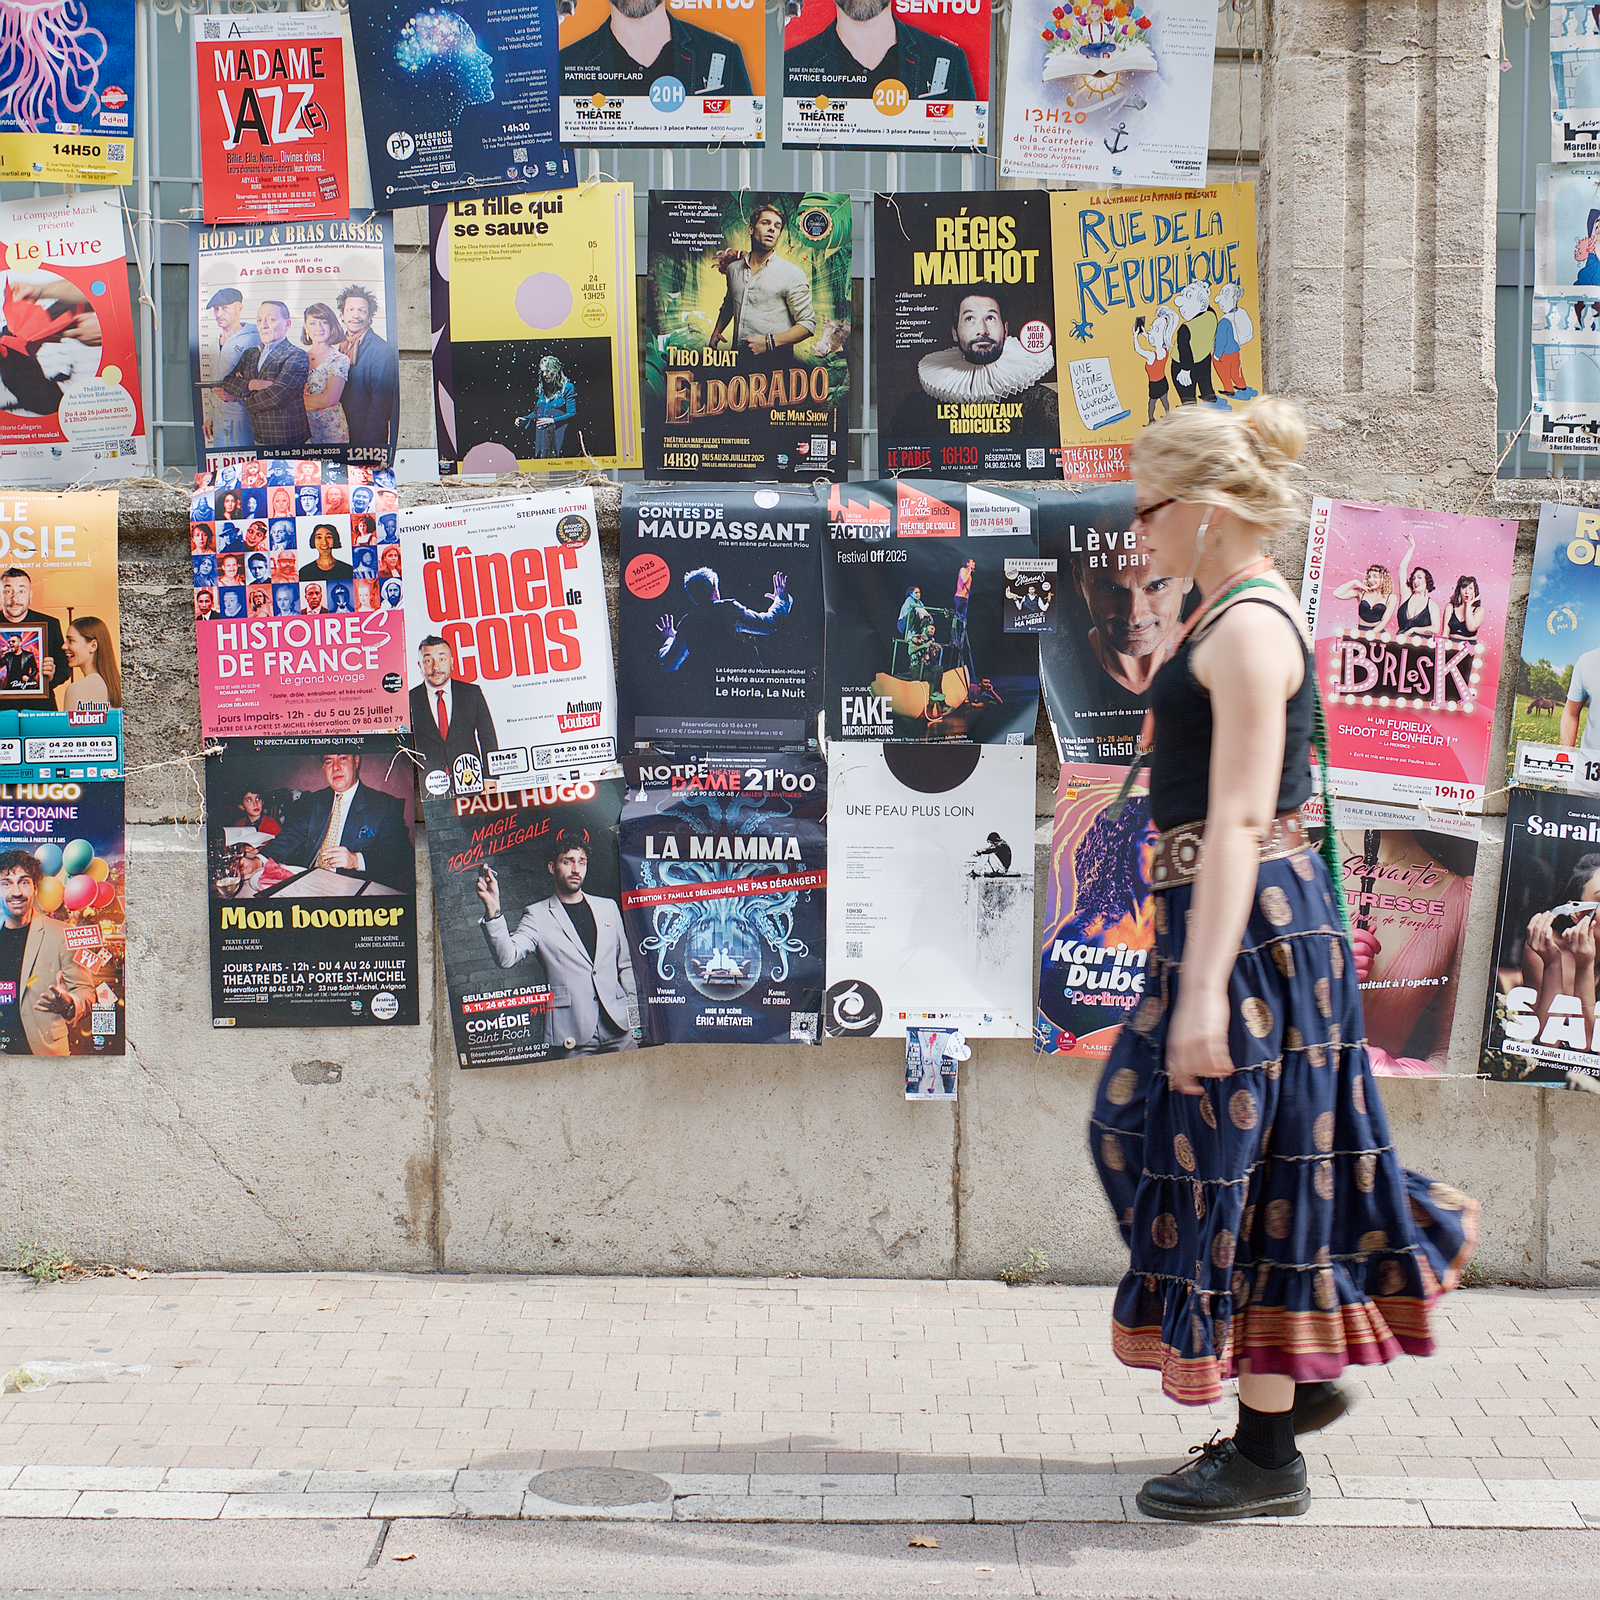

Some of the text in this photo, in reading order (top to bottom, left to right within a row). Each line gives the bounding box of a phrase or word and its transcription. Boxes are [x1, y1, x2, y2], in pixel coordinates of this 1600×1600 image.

[896, 0, 980, 14] SENTOU
[214, 48, 326, 82] MADAME
[822, 75, 867, 83] SOUFFLARD
[652, 86, 683, 102] 20H
[876, 90, 907, 106] 20H
[576, 108, 622, 119] THÉÂTRE
[799, 110, 844, 121] THÉÂTRE
[1025, 109, 1087, 124] 13H20
[415, 130, 452, 140] PRÉSENCE
[502, 123, 530, 133] 14h30
[1033, 125, 1072, 135] Théâtre
[415, 138, 453, 147] PASTEUR
[1029, 135, 1037, 143] la
[1042, 136, 1094, 146] Carreterie
[1564, 142, 1597, 151] Marelle
[53, 144, 101, 156] 14H50
[281, 150, 321, 162] Divines divas
[12, 205, 97, 221] La Compagnie Mazik
[454, 195, 563, 219] La fille qui
[37, 220, 75, 231] présente
[454, 221, 548, 237] se sauve
[936, 207, 1016, 250] RÉGIS
[199, 229, 264, 251] HOLD-UP
[270, 227, 280, 244] &
[285, 224, 324, 243] BRAS
[1079, 209, 1222, 257] RUE DE LA
[14, 238, 102, 260] Le Livre
[240, 265, 341, 276] Arsène Mosca
[913, 250, 1039, 285] MAILHOT
[581, 283, 606, 291] JUILLET
[1073, 362, 1092, 376] UNE
[937, 403, 1023, 419] LES NOUVEAUX
[950, 418, 1011, 434] RIDICULES
[1542, 434, 1591, 444] Marelle des
[347, 448, 387, 462] 12H25
[663, 453, 698, 467] 14H30
[941, 447, 978, 464] 16H30
[1065, 447, 1122, 461] THÉÂTRE DES
[1064, 461, 1090, 474] CORPS
[516, 504, 587, 518] STEPHANE BATTINI
[639, 507, 724, 520] CONTES DE
[931, 507, 950, 516] 15h35
[970, 505, 1020, 514] www.la-factory.org
[400, 519, 467, 534] NTHONY JOUBERT
[638, 520, 810, 541] MAUPASSANT
[422, 543, 435, 559] le
[837, 550, 907, 563] Festival Off 2025
[1309, 508, 1328, 594] du GIRASOLE
[1090, 553, 1107, 568] et
[632, 560, 655, 576] 16h25
[423, 545, 578, 622] dîner
[566, 588, 582, 606] de
[441, 609, 581, 684] cons
[218, 647, 380, 678] DE FRANCE
[280, 673, 365, 686] Le grand voyage
[716, 687, 805, 698] Le Horla, La Nuit
[77, 700, 110, 712] Anthony
[567, 700, 602, 714] Anthony
[841, 696, 893, 725] FAKE
[70, 712, 105, 724] Joubert
[560, 713, 597, 730] Joubert
[842, 725, 893, 736] MICROFICTIONS
[1387, 720, 1432, 733] FURIEUX
[1338, 725, 1443, 746] SHOOT DE BONHEUR
[491, 753, 518, 761] 11h45
[1098, 743, 1133, 757] 15h50
[639, 764, 708, 781] NOTRE
[671, 774, 741, 791] DAME
[17, 783, 80, 800] HUGO
[1434, 786, 1475, 800] 19h10
[457, 782, 596, 816] PAUL HUGO
[18, 807, 78, 818] FORAINE
[846, 805, 974, 817] UNE PEAU PLUS LOIN
[0, 820, 53, 833] AGIQUE
[471, 813, 518, 844] MAGIE
[1527, 815, 1600, 842] Sarah
[488, 818, 550, 856] ILLEGALE
[645, 836, 802, 860] LA MAMMA
[1341, 855, 1448, 891] Servante
[737, 877, 816, 892] NE PAS DÉRANGER
[1346, 890, 1445, 916] TRESSE
[221, 905, 404, 930] Mon boomer
[67, 929, 93, 938] SUCCÈS
[69, 936, 99, 946] REPRISE
[1051, 940, 1147, 967] Karin
[223, 959, 405, 973] JOURS PAIRS 12h DU 4 AU 26 JUILLET
[1066, 964, 1146, 992] Dube
[1401, 976, 1438, 987] l'opéra
[463, 989, 512, 1003] SEULEMENT
[520, 985, 546, 995] DATES
[518, 993, 550, 1005] JUILLET
[465, 1013, 530, 1033] COMÉDIE
[696, 1015, 753, 1027] ÉRIC MÉTAYER
[468, 1027, 531, 1045] Saint Roch
